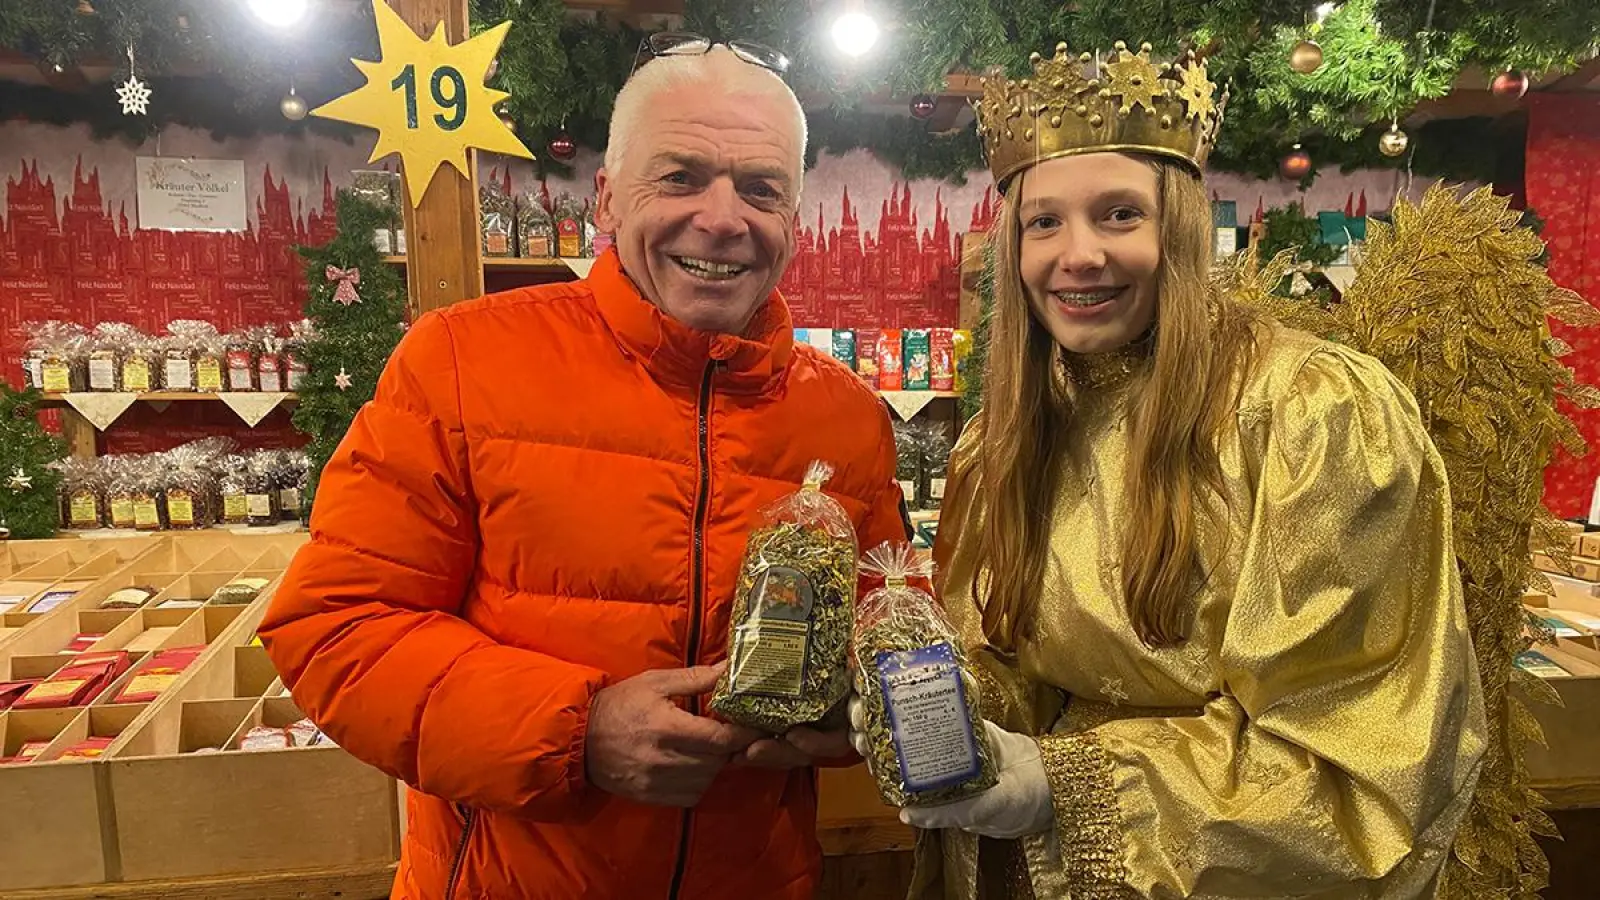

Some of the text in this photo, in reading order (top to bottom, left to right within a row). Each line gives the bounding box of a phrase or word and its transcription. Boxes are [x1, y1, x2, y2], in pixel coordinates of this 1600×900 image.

[391, 64, 467, 131] 19
[76, 281, 123, 289] Feliz Navidad
[167, 282, 196, 290] Navidad
[240, 283, 270, 291] Navidad
[891, 687, 957, 706] Punsch-Kräutertee
